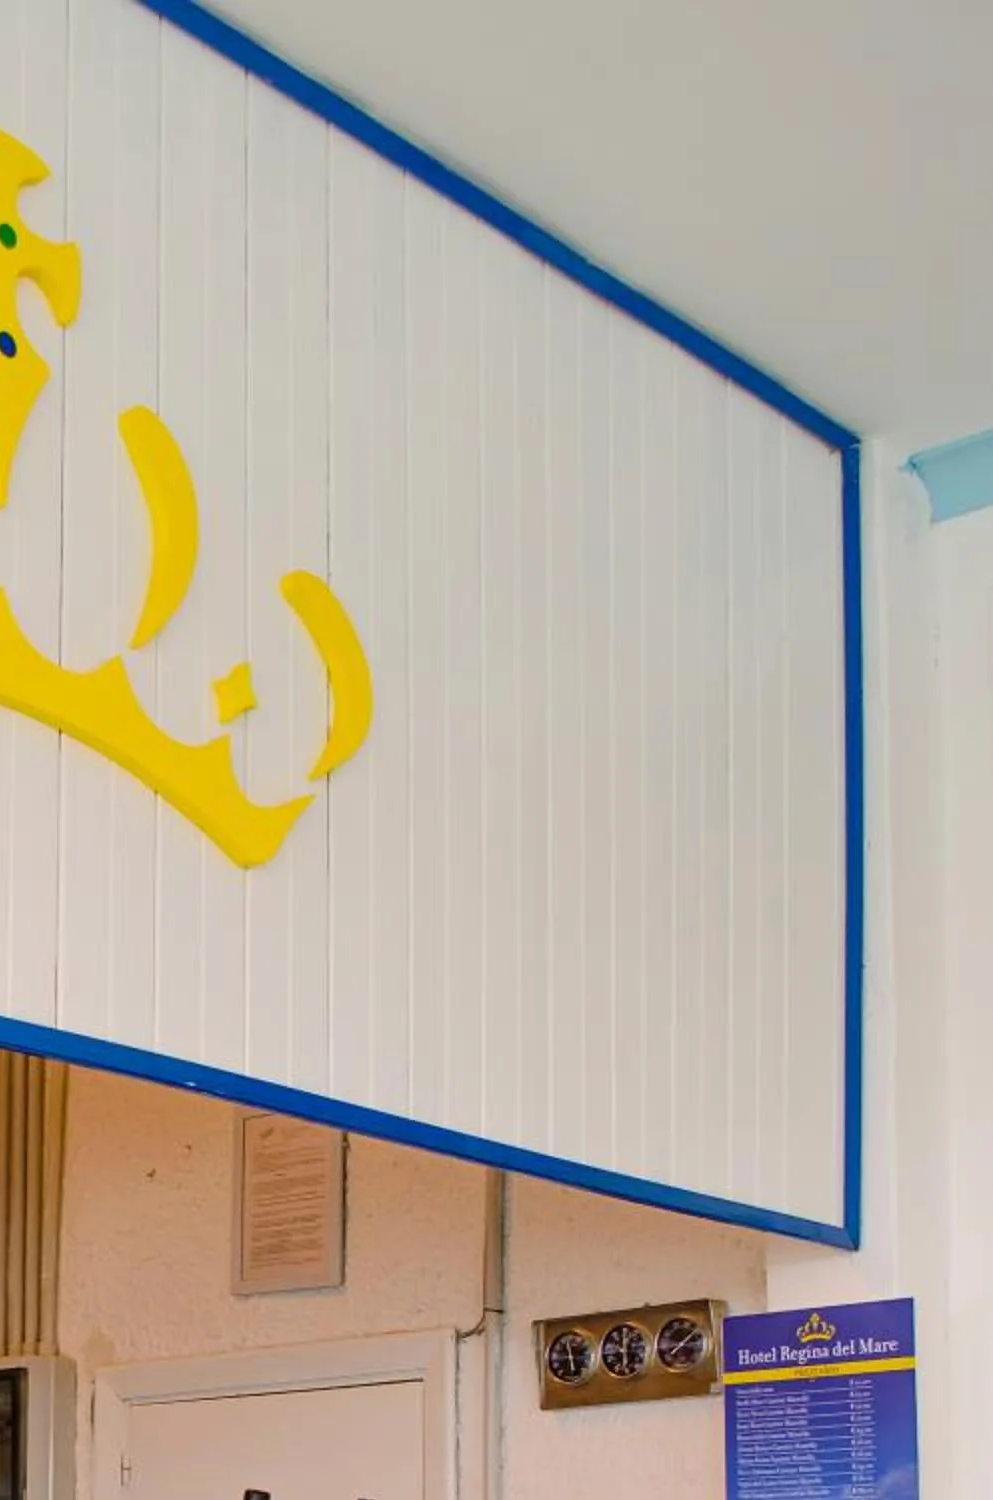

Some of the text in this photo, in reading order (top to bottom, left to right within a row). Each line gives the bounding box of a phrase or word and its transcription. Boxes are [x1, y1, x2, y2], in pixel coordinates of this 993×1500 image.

[738, 1337, 900, 1365] Hotel Regina del Mare
